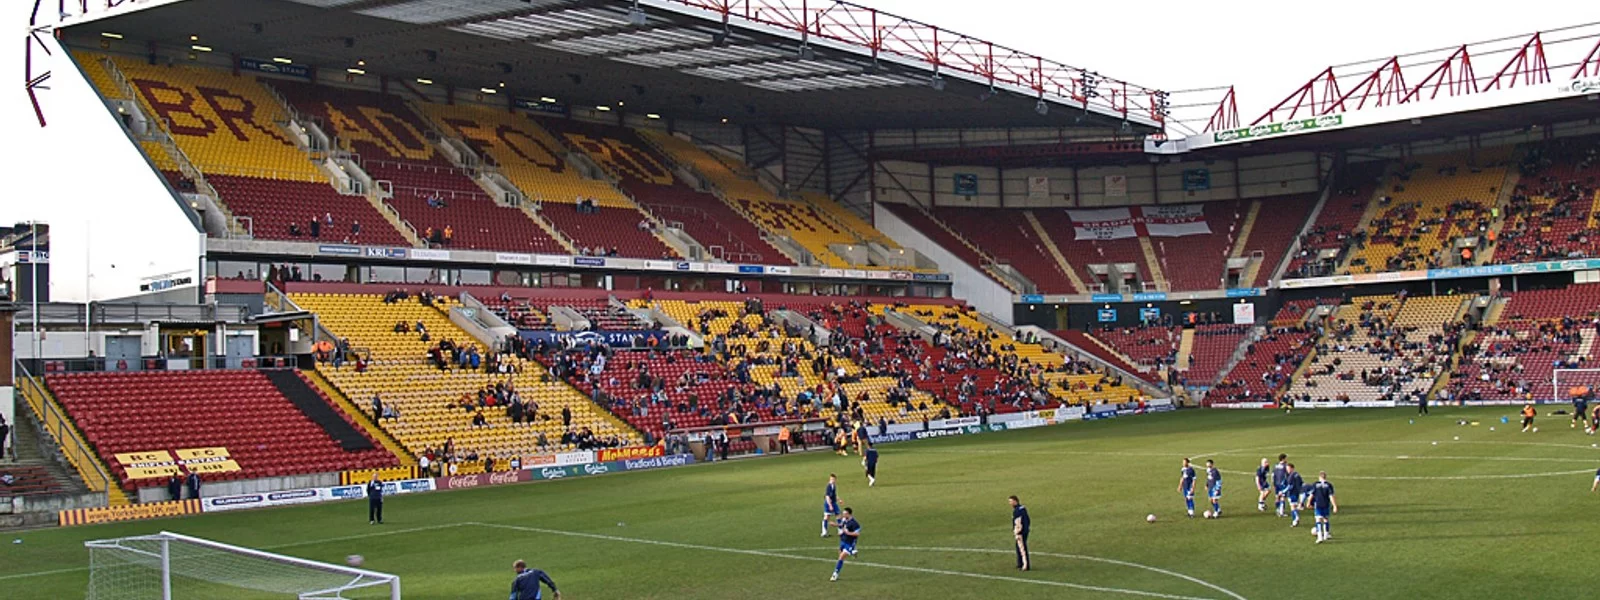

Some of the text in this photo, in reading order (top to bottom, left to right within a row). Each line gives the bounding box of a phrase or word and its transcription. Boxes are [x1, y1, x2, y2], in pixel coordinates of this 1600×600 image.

[1083, 216, 1197, 227] BRADFORD CITY
[625, 457, 655, 470] Bradford
[662, 454, 687, 467] Bingley
[448, 474, 478, 488] Coca-Cola
[489, 471, 519, 484] Coca-Cola
